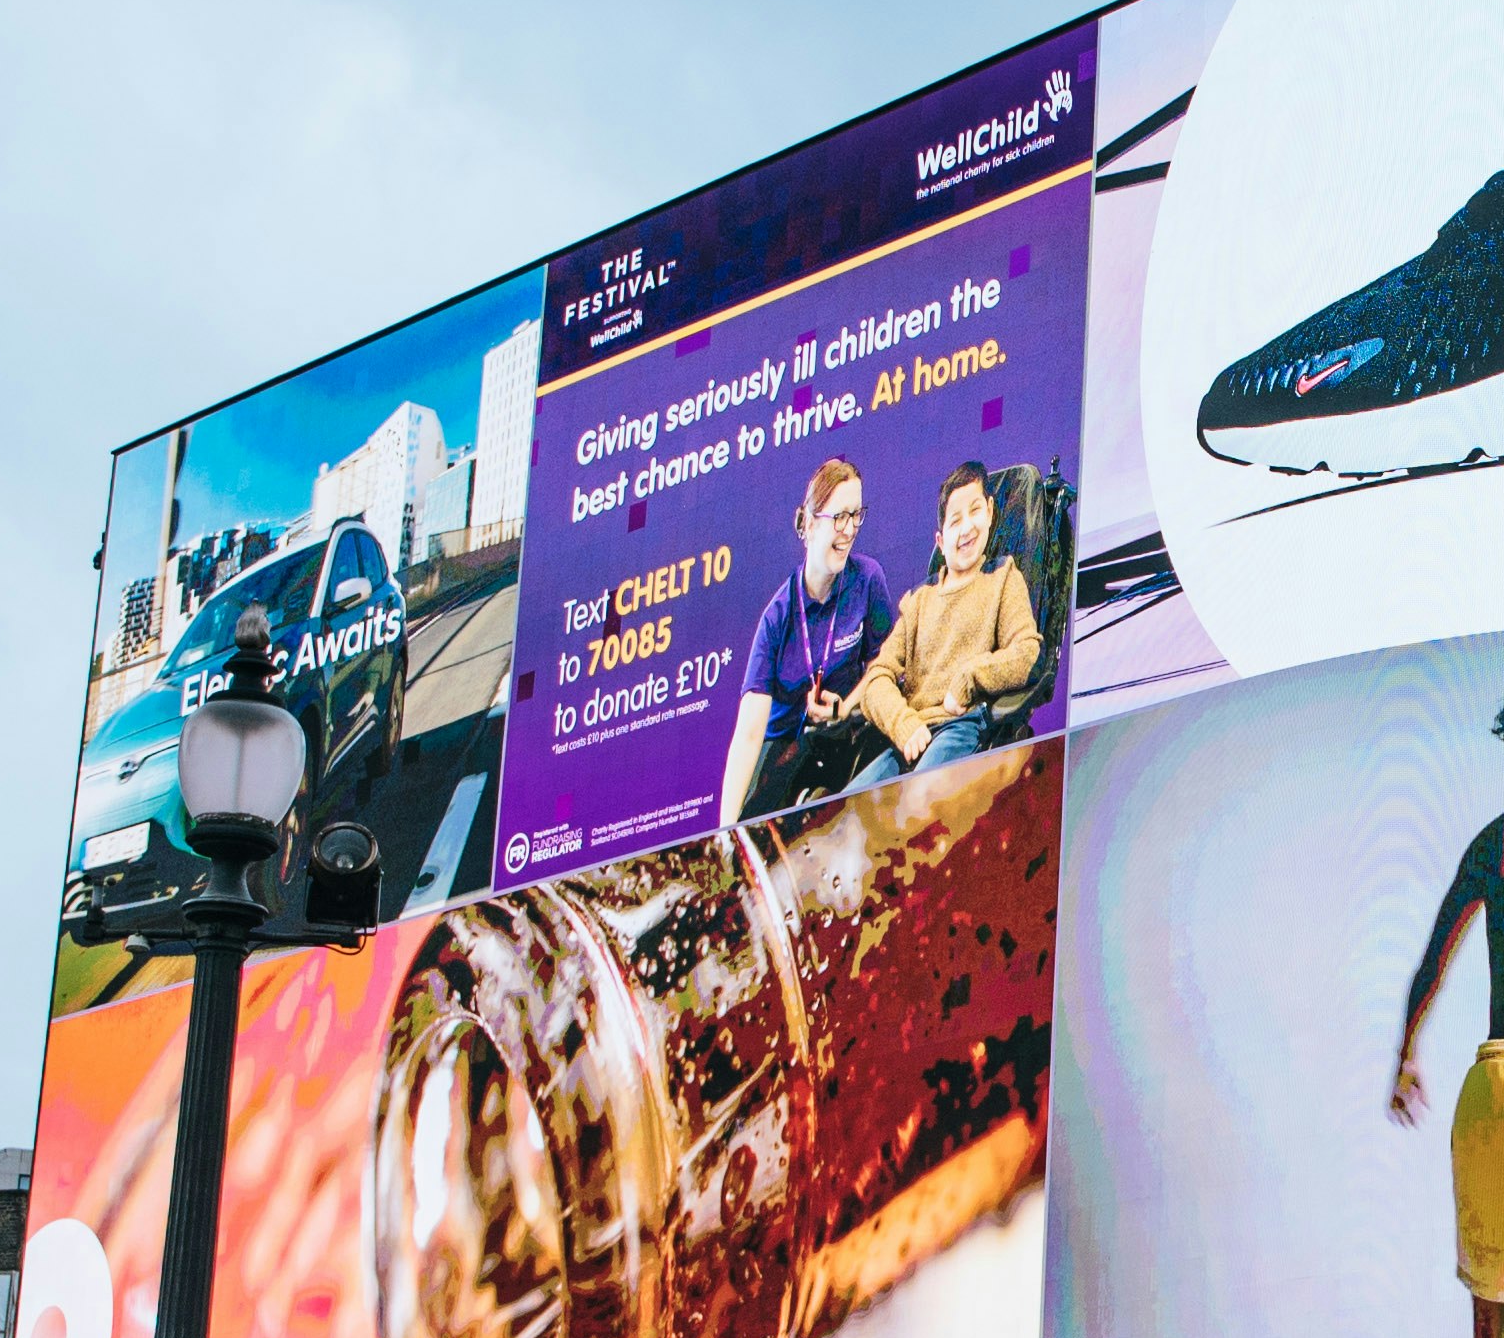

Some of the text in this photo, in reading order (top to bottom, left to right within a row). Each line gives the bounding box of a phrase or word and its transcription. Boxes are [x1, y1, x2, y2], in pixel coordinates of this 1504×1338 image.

[916, 134, 1055, 200] the national charity for sick children
[917, 99, 1040, 181] WellChild
[601, 247, 643, 283] THE
[590, 319, 633, 348] WellChild
[576, 278, 1001, 466] Giving seriously ill children the
[571, 338, 1007, 524] best chance to thrive. At home.
[563, 545, 732, 635] Text CHELT 10
[292, 605, 402, 677] Awaits
[558, 615, 673, 686] to 70085
[554, 702, 577, 737] to
[582, 672, 669, 727] donate
[569, 736, 586, 751] costs
[587, 730, 600, 745] £10
[600, 727, 615, 743] plus
[615, 724, 629, 736] one
[630, 712, 661, 732] standard
[661, 709, 675, 721] rate
[509, 843, 526, 864] FR
[531, 838, 583, 863] REGULATOR
[532, 827, 583, 851] FUNDRAISING
